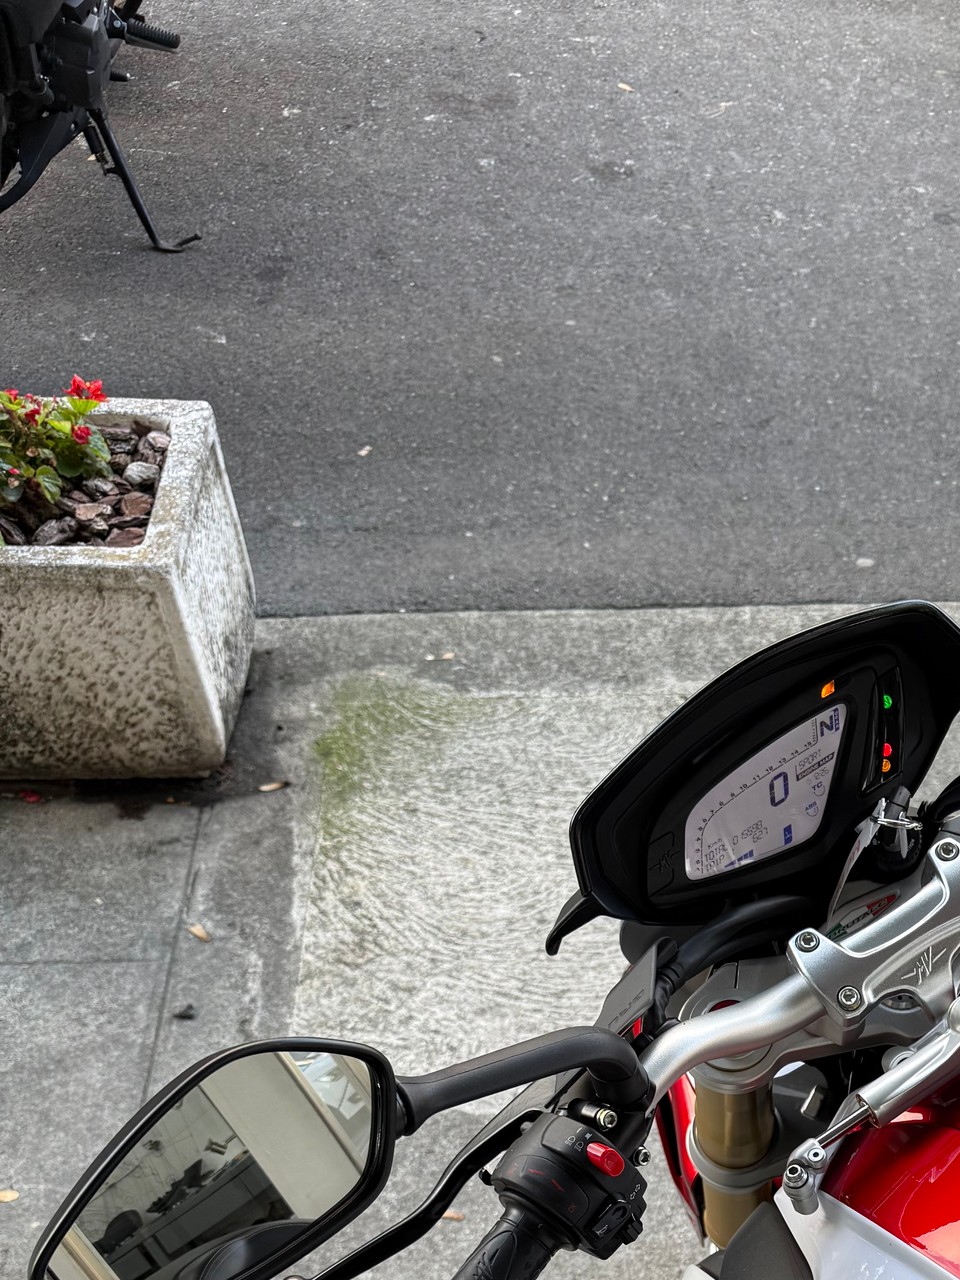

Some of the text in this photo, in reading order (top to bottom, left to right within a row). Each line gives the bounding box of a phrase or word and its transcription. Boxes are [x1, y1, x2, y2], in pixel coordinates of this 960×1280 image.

[820, 714, 834, 737] N
[769, 771, 789, 808] 0
[812, 781, 823, 791] TC
